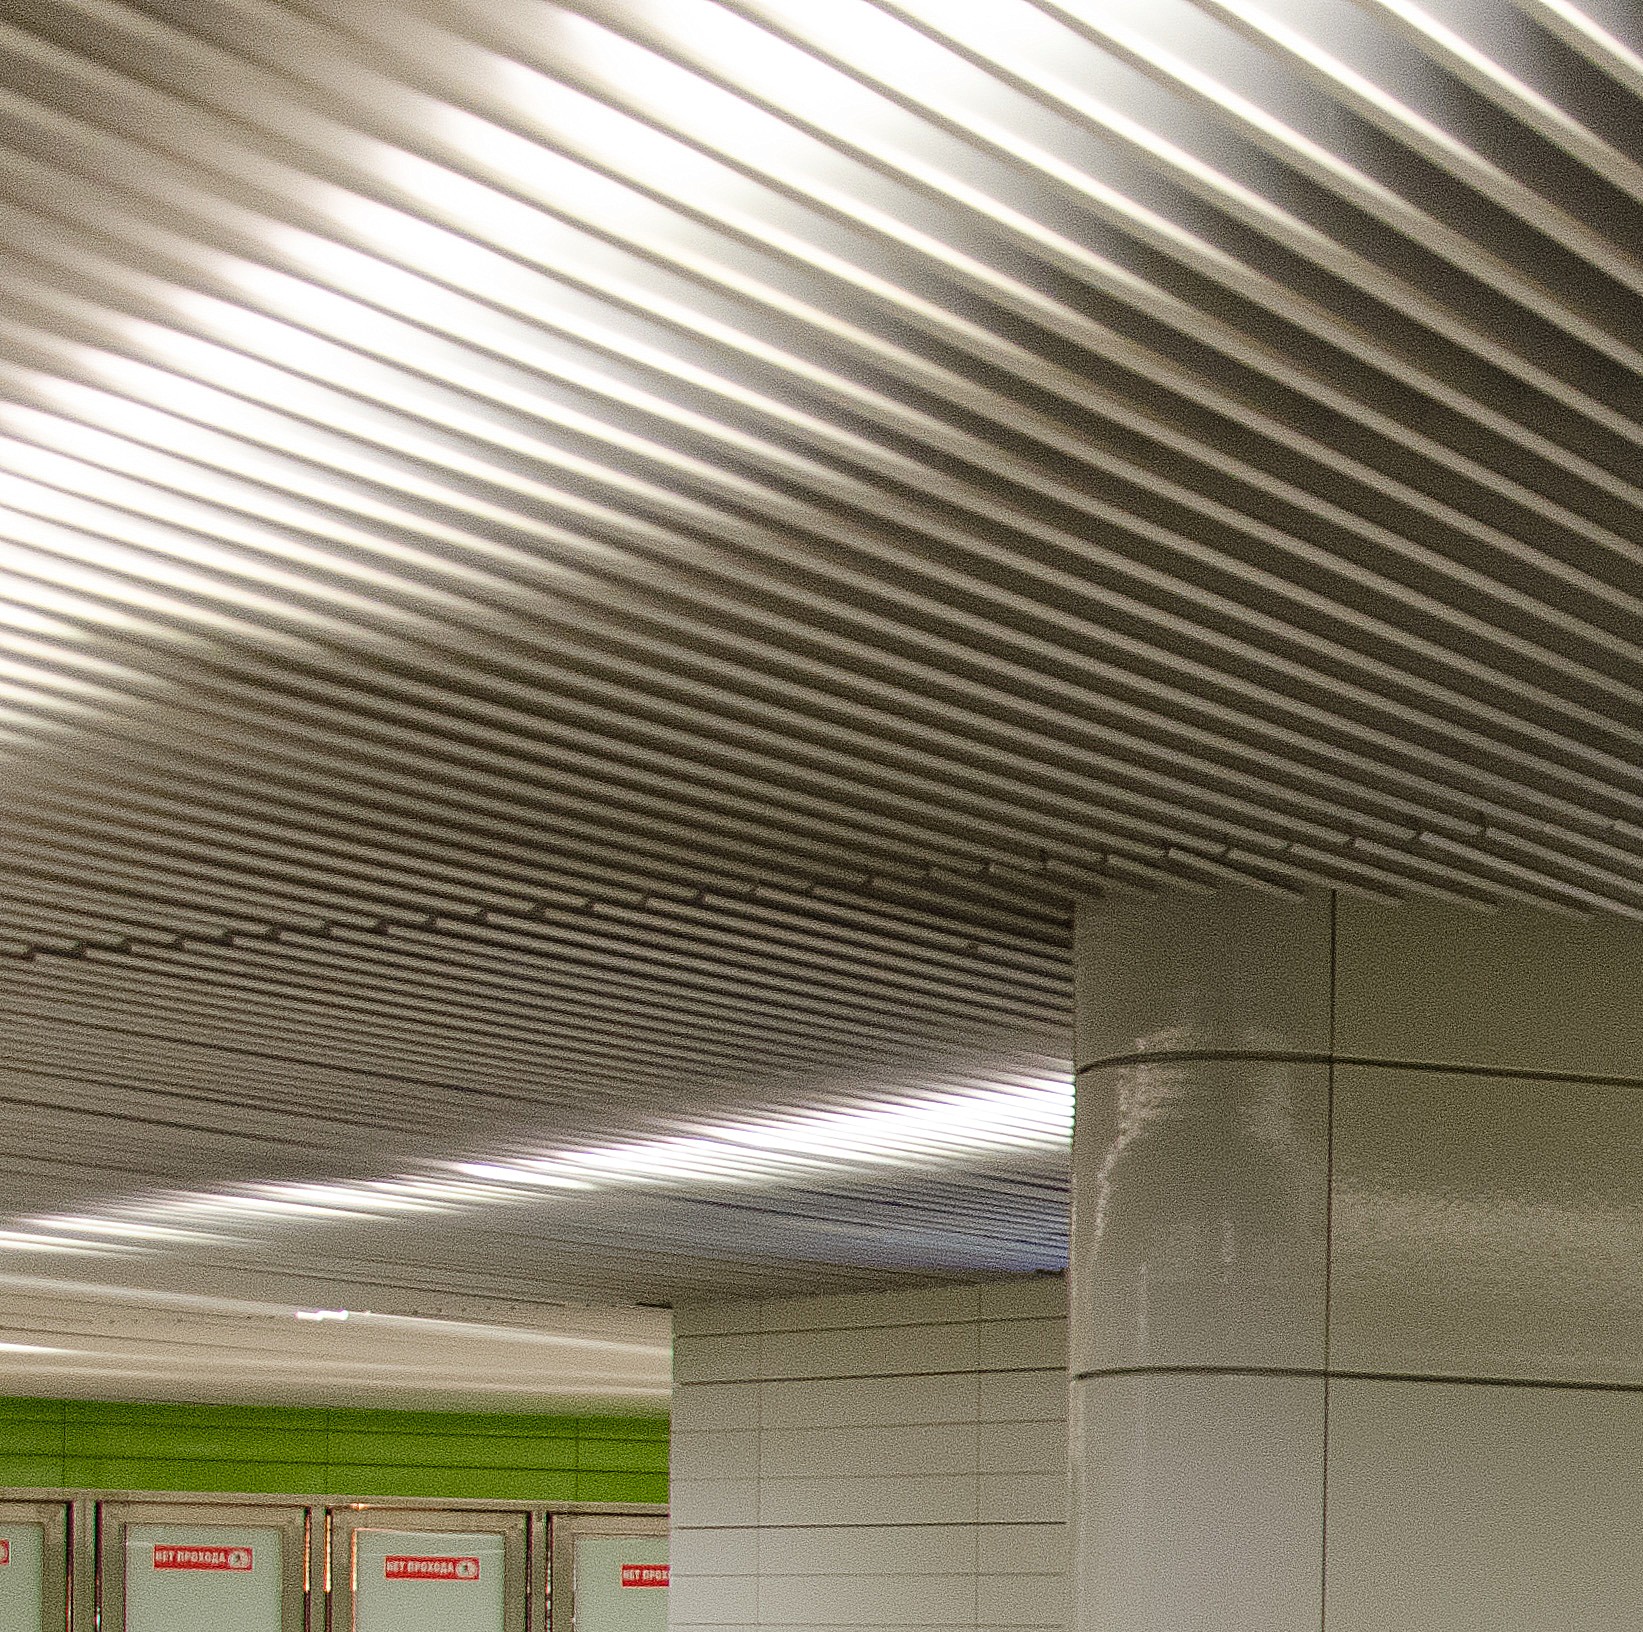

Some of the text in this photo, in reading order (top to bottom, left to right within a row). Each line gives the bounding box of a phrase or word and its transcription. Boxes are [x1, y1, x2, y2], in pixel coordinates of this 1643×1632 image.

[155, 1551, 226, 1564] НЕТ ПРОХОДА
[386, 1561, 455, 1574] НЕТ ПРОХОДА
[642, 1569, 670, 1581] ПРОХ
